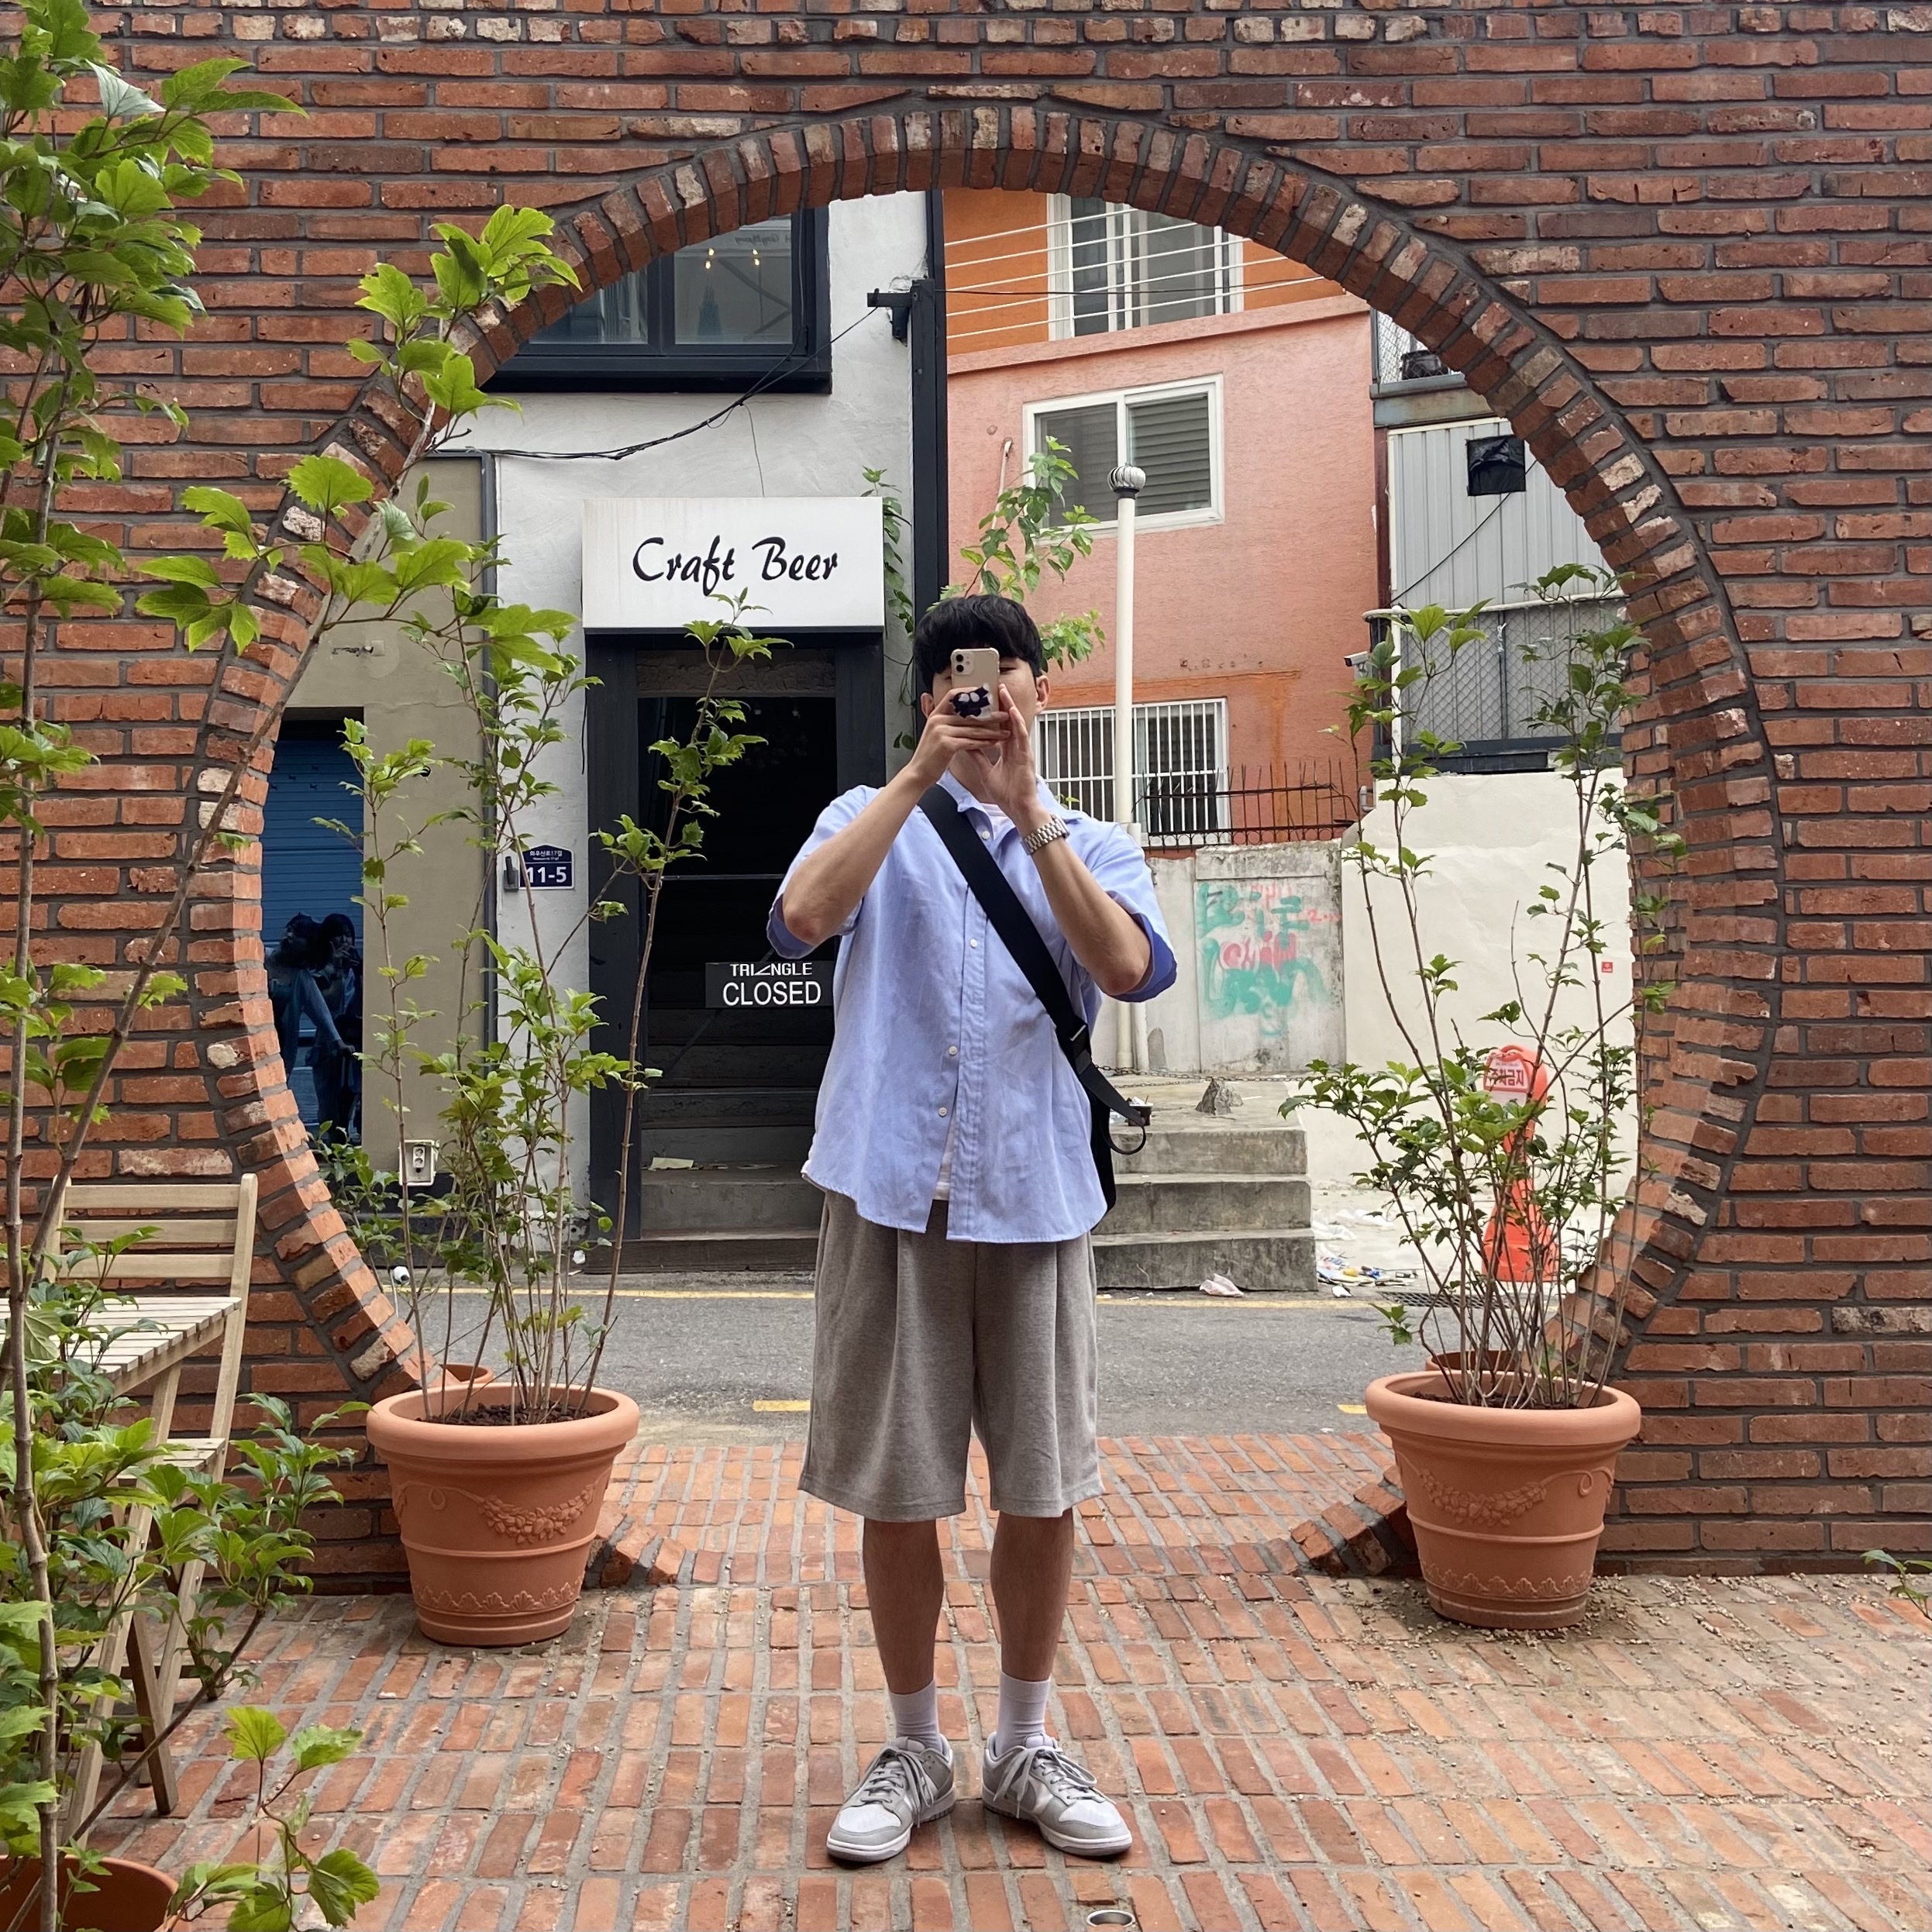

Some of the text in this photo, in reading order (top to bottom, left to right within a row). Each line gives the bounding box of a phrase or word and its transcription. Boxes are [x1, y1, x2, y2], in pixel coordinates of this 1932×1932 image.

[632, 535, 838, 596] Craft Beer
[526, 866, 567, 883] 11-5
[722, 980, 821, 1006] CLOSED
